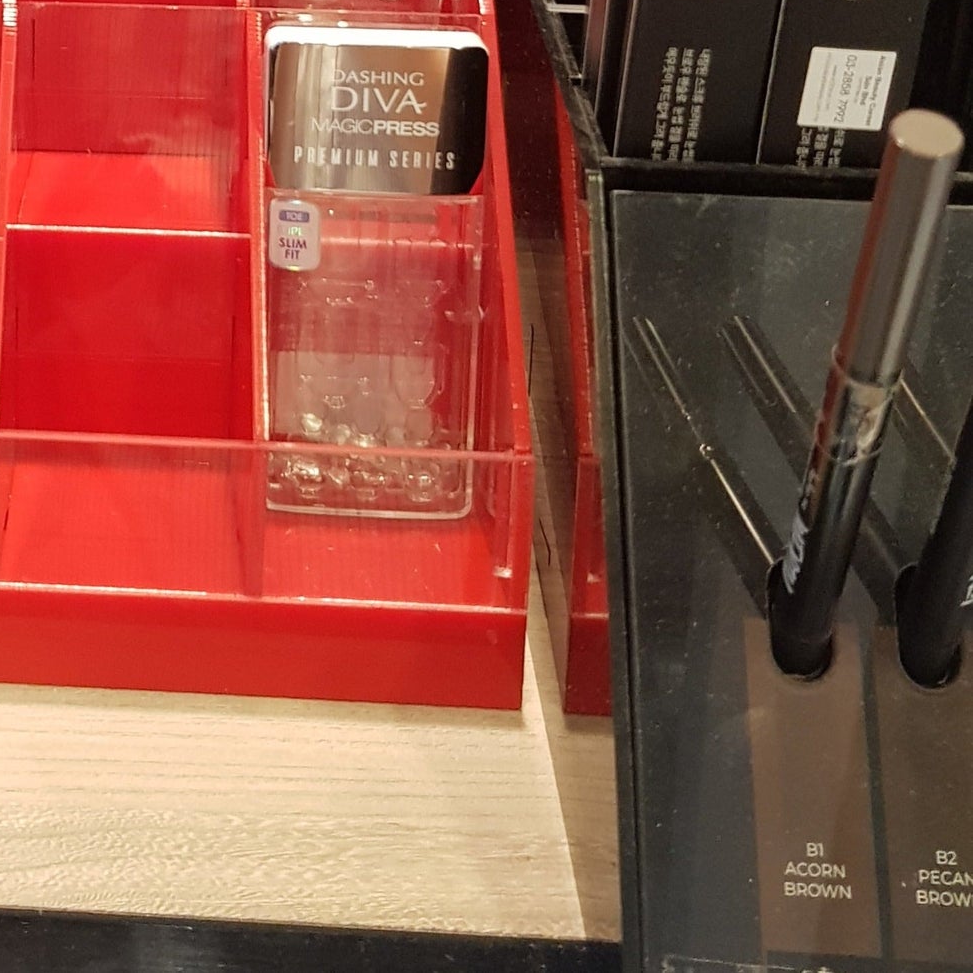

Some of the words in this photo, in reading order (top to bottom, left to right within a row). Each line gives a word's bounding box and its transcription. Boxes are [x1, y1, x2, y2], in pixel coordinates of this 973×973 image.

[333, 69, 425, 86] DASHING
[330, 86, 428, 115] DIVA
[311, 118, 440, 139] MAGICPRESS
[294, 145, 378, 167] PREMIUM
[389, 150, 456, 171] SERIES
[278, 237, 307, 249] SLIM
[284, 248, 300, 260] FIT
[806, 842, 825, 857] B1
[935, 850, 958, 866] B2
[784, 861, 846, 878] ACORN
[783, 881, 852, 900] BROWN
